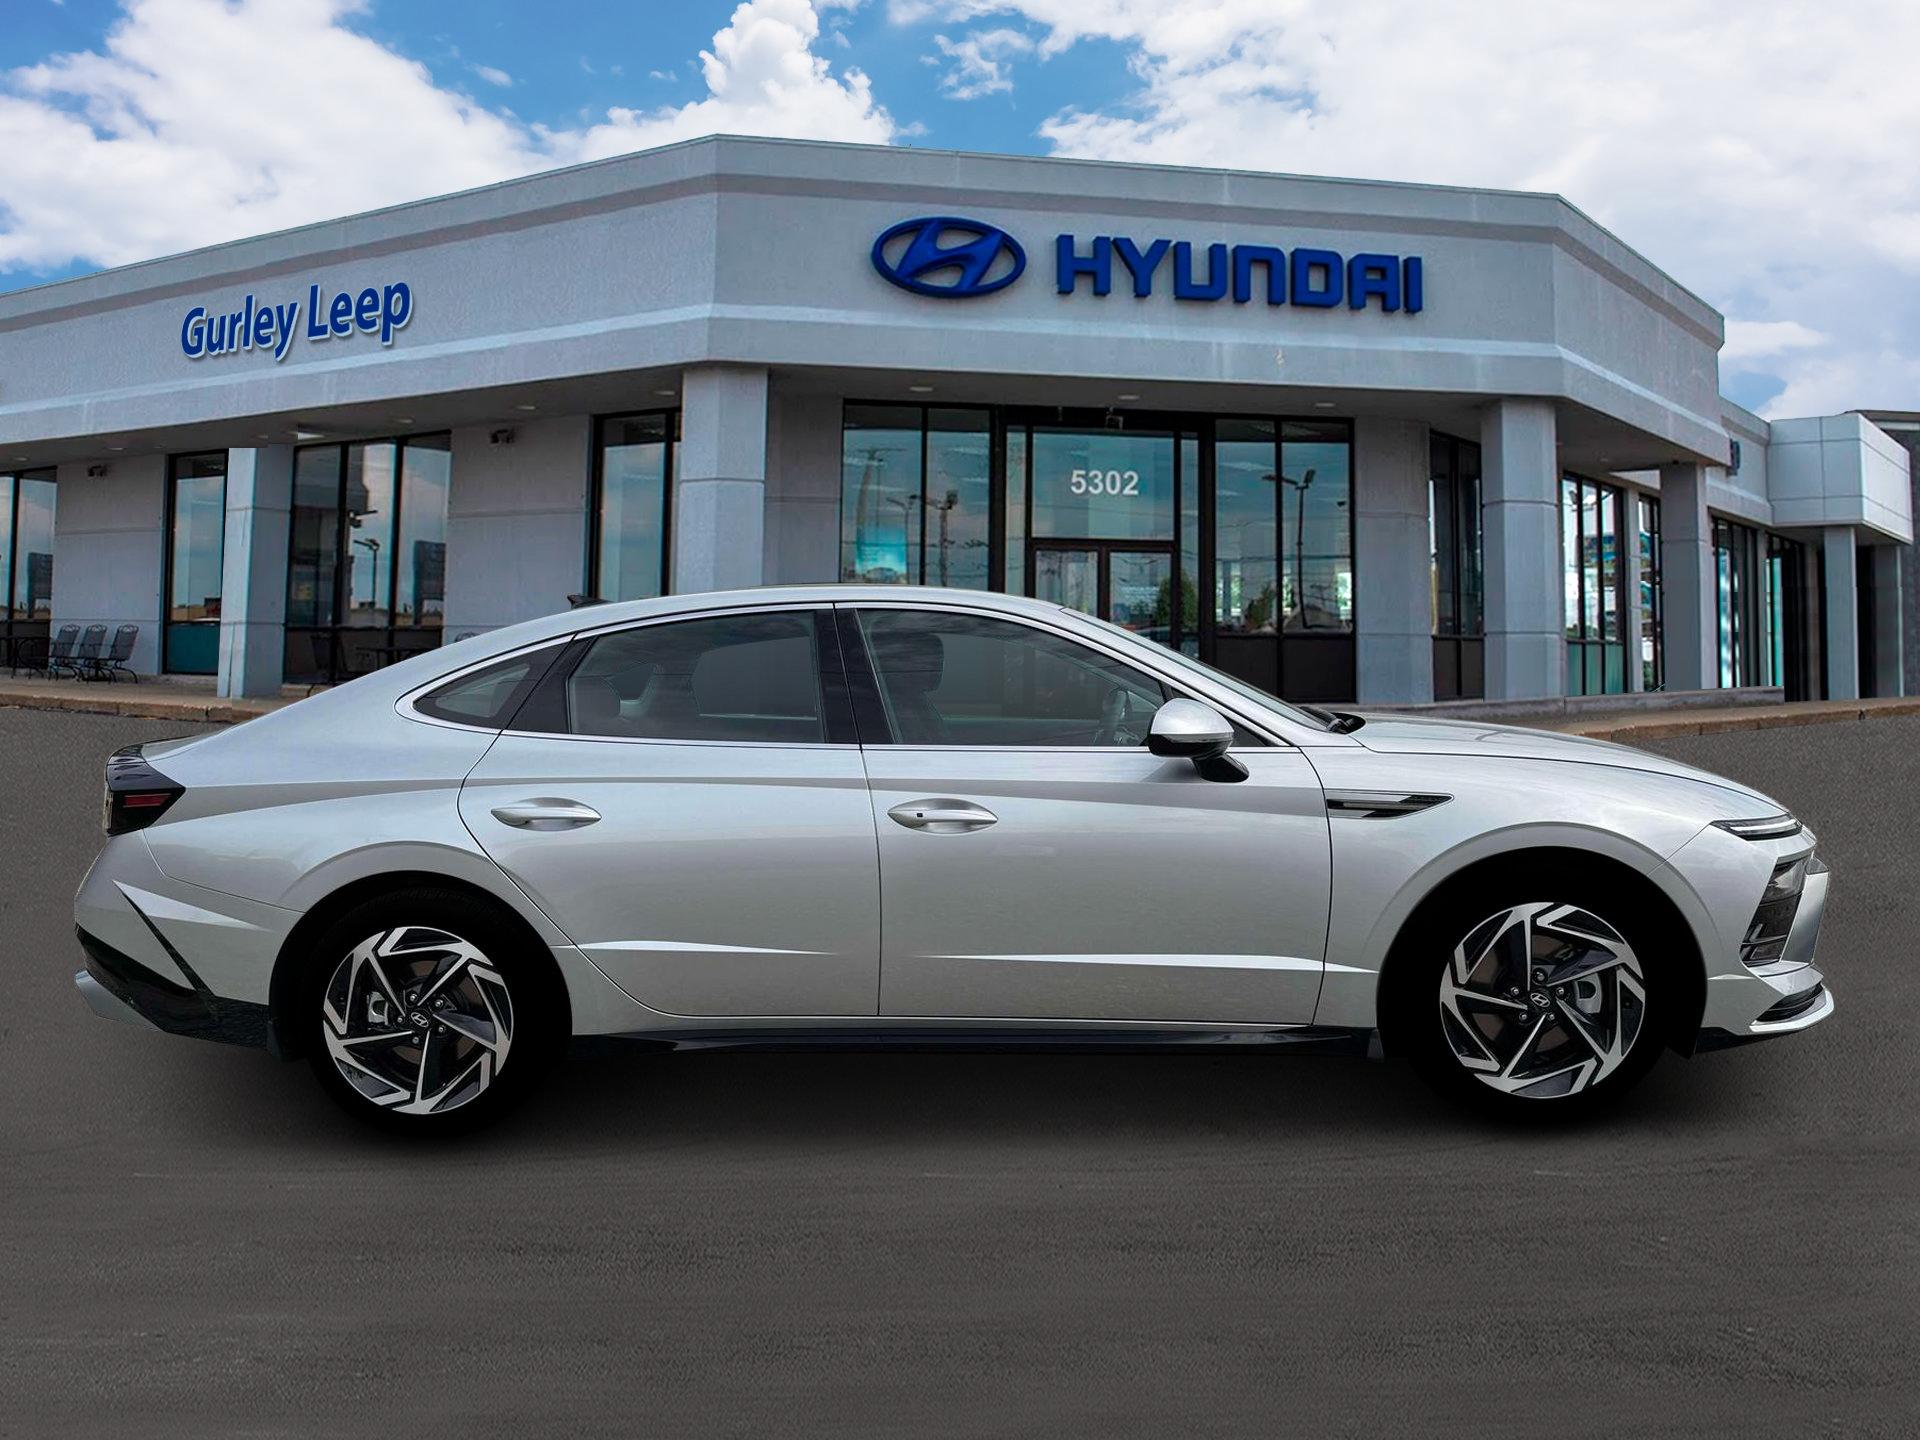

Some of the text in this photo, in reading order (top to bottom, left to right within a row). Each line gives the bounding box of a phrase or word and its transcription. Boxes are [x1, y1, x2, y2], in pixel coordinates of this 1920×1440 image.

[1056, 234, 1423, 314] HYUNDAI
[181, 281, 413, 362] Gurley Leep
[1070, 469, 1139, 496] 5302
